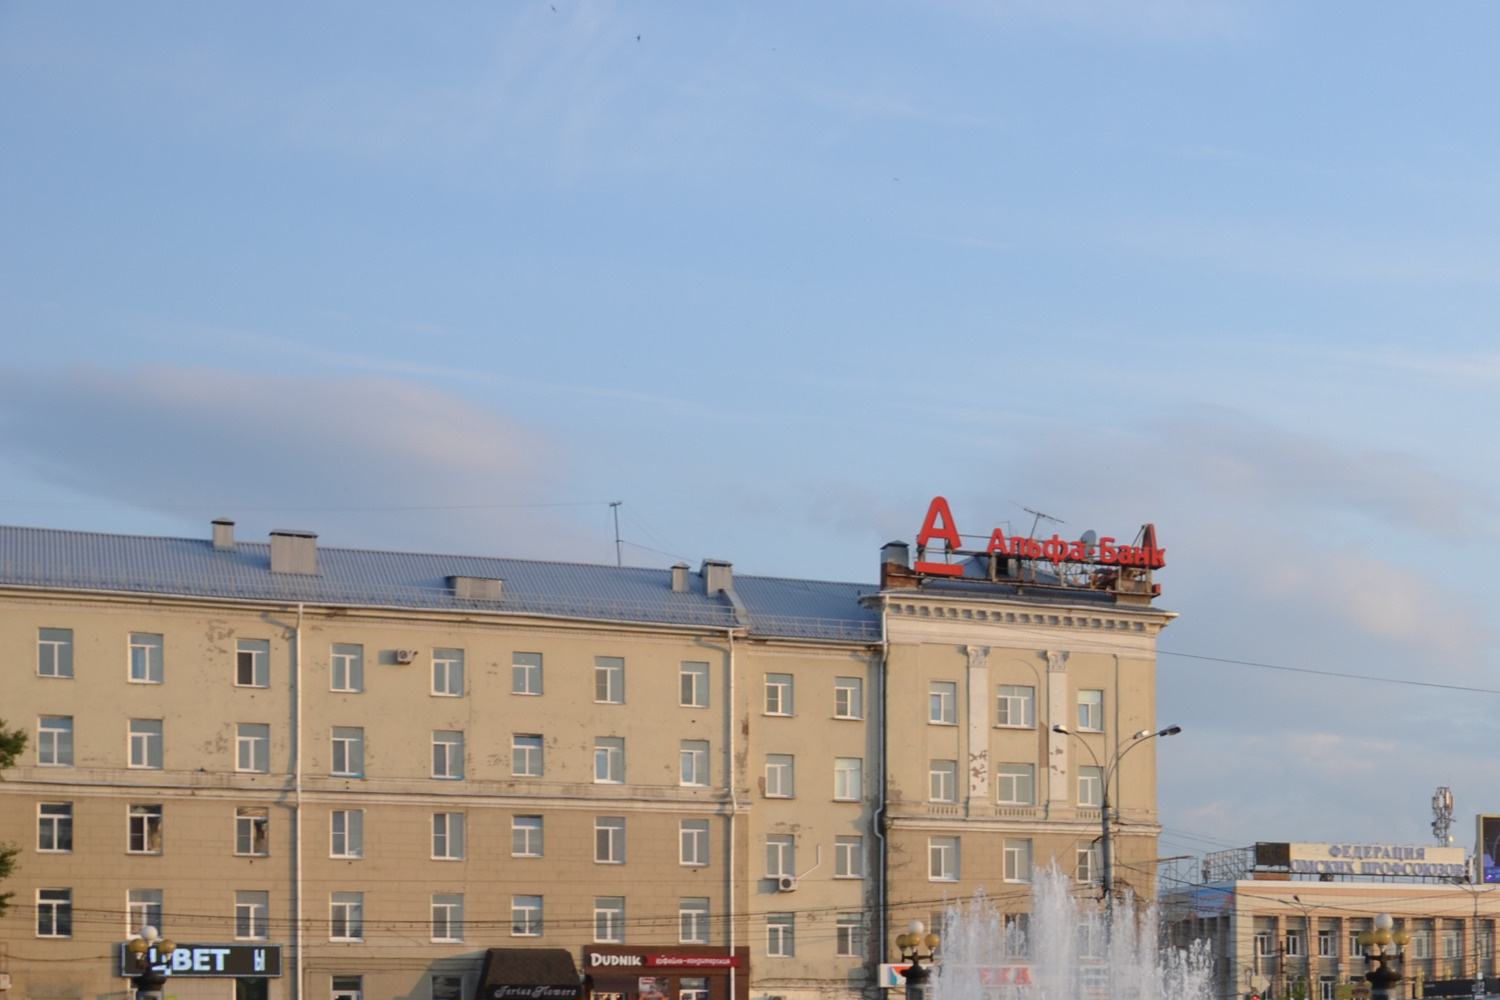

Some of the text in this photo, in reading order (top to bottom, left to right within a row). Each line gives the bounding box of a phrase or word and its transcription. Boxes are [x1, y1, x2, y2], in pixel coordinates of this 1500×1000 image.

[1328, 844, 1426, 860] ФЕДЕРАЦИЯ
[1290, 859, 1465, 877] ОМСКИХ ПРОФСОЮЗОВ
[590, 952, 642, 967] DUDNIK
